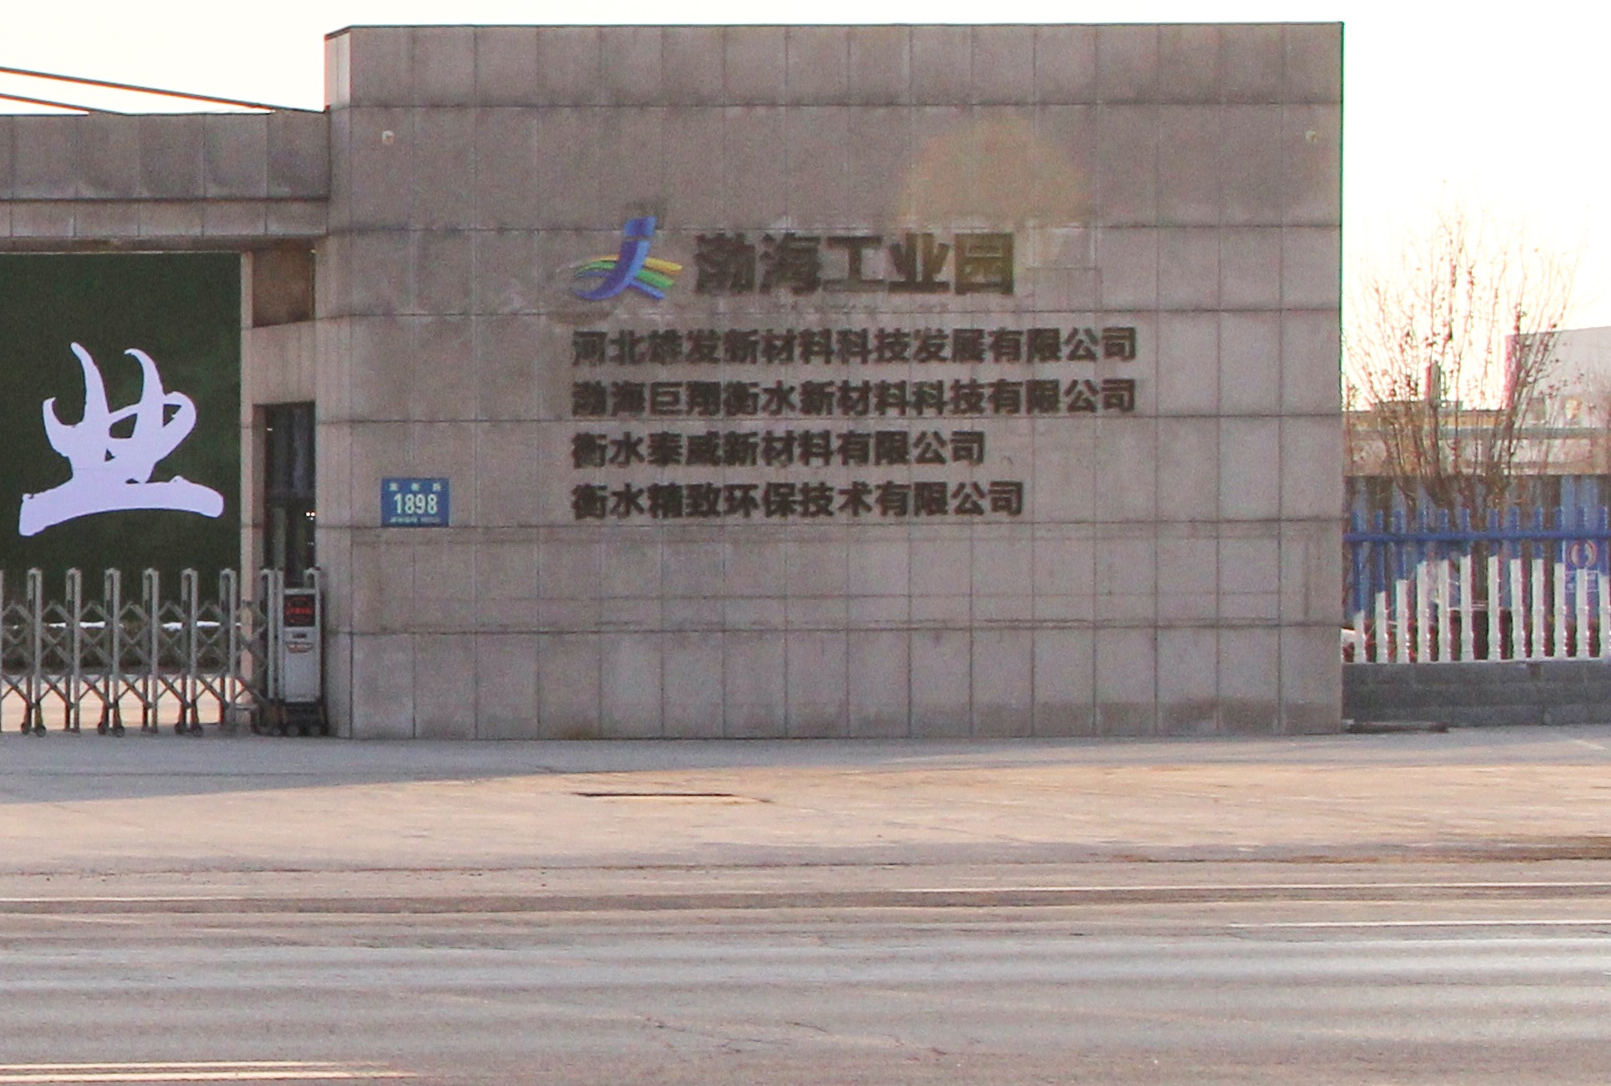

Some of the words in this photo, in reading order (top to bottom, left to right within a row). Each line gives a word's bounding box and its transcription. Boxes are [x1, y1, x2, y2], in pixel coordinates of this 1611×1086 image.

[695, 232, 1015, 296] 渤海工业园
[393, 493, 438, 515] 1898
